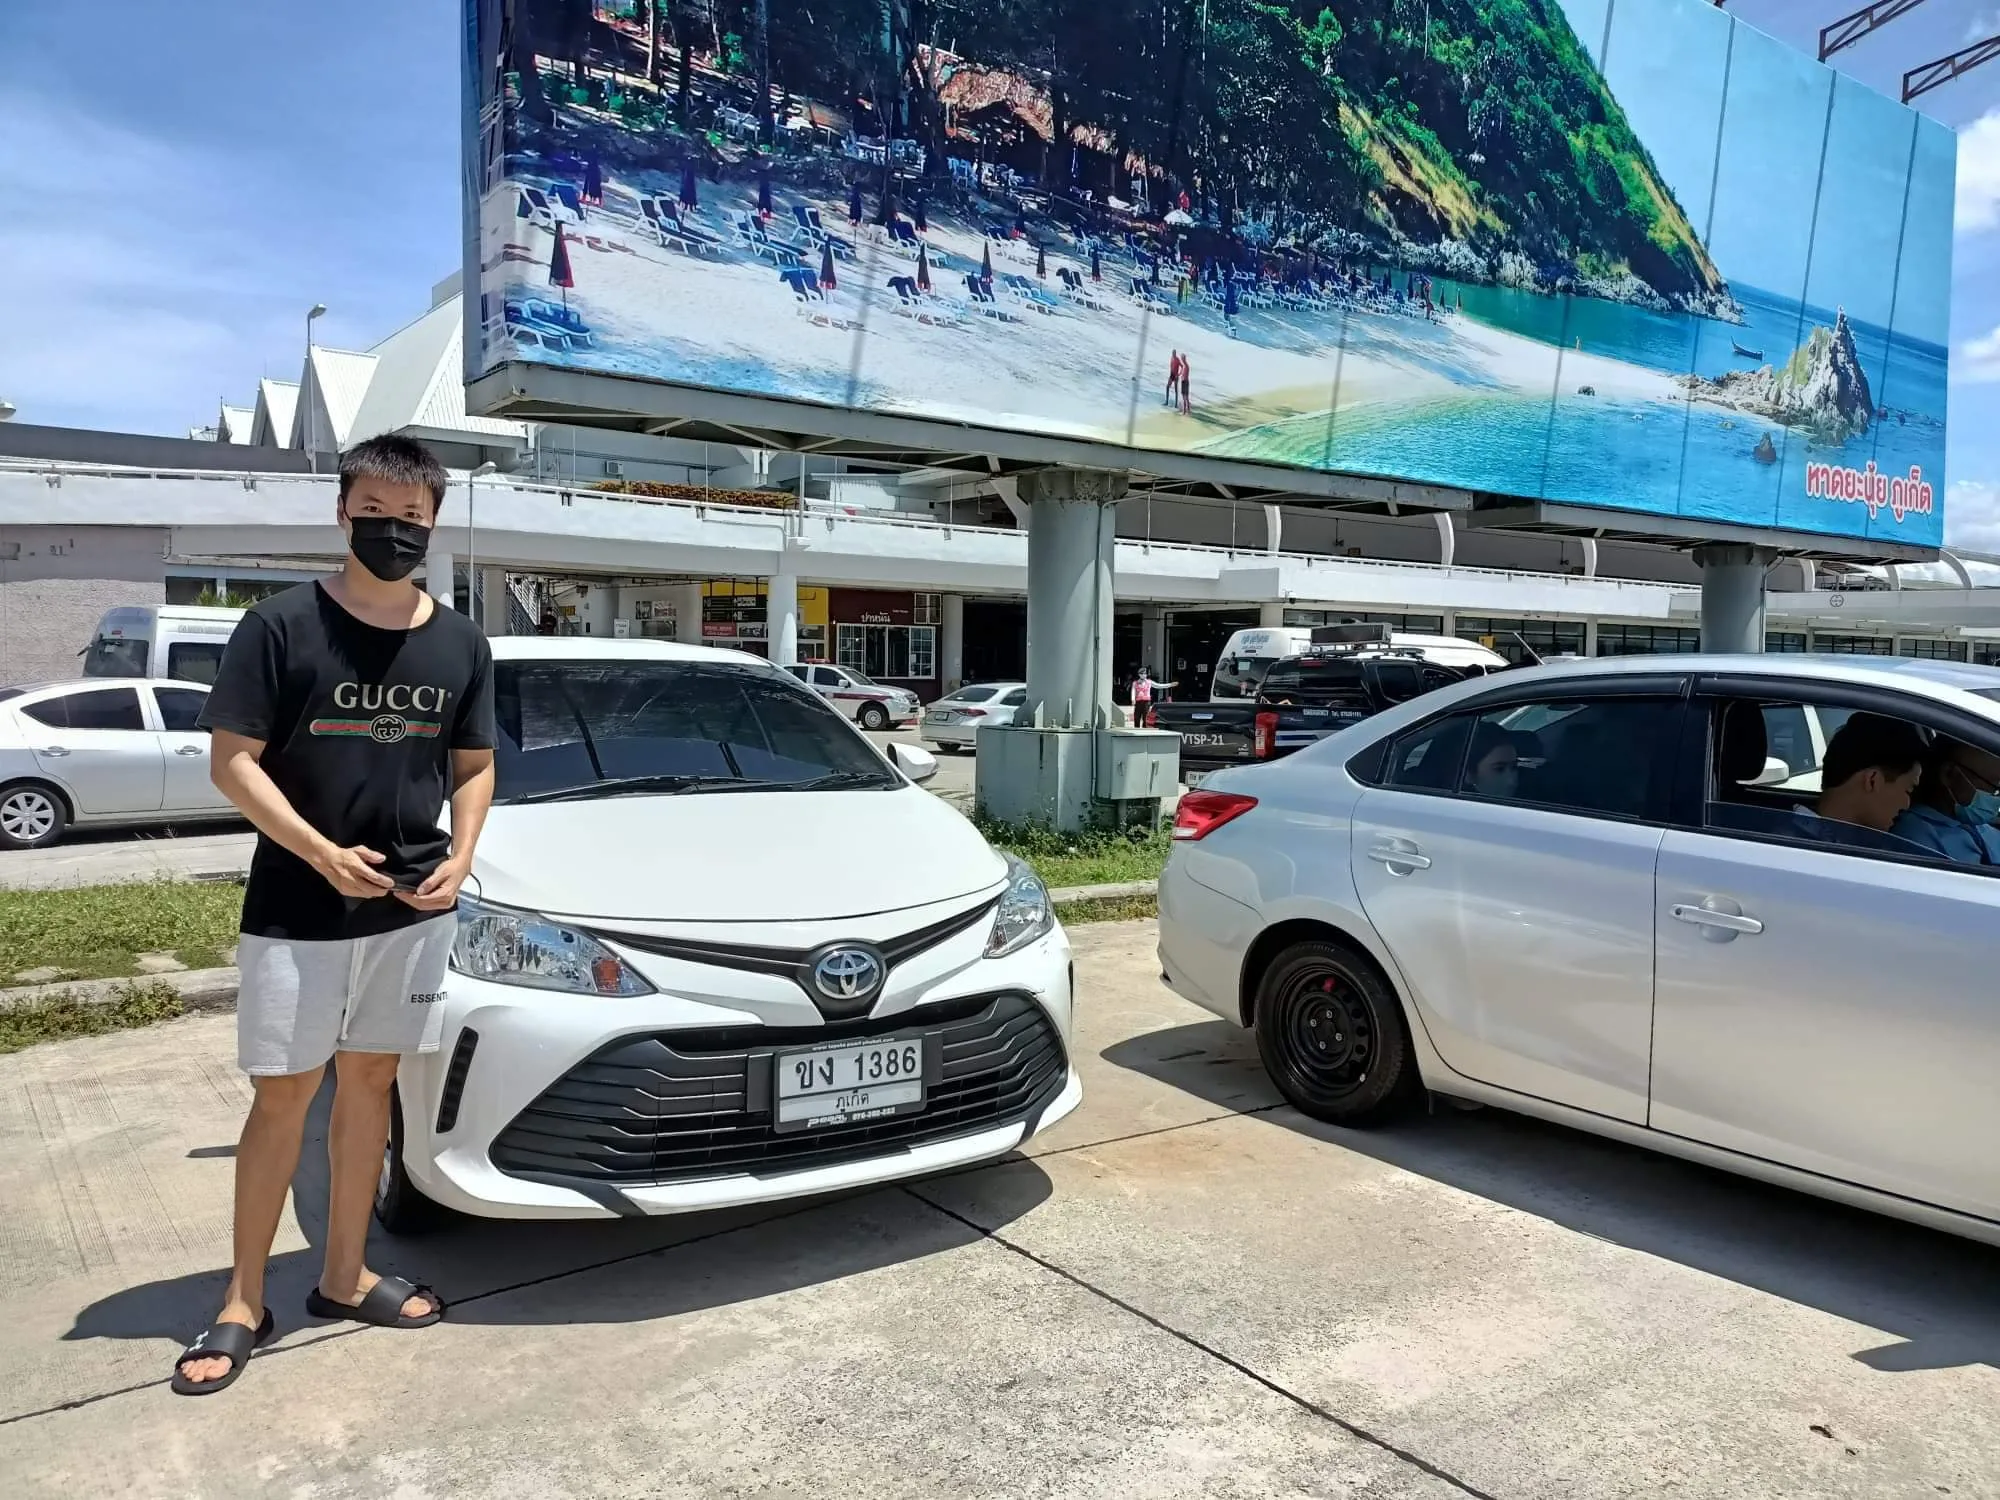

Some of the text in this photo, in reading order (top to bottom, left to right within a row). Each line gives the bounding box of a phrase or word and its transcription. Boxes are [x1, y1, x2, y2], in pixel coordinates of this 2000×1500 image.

[1807, 461, 1932, 522] หาดยะนุ้ย ภูเก็ต
[333, 682, 446, 713] GUCCI
[1181, 733, 1225, 746] VTSP-21
[796, 1047, 916, 1089] ขง 1386
[836, 1089, 869, 1112] ภูเก็ต
